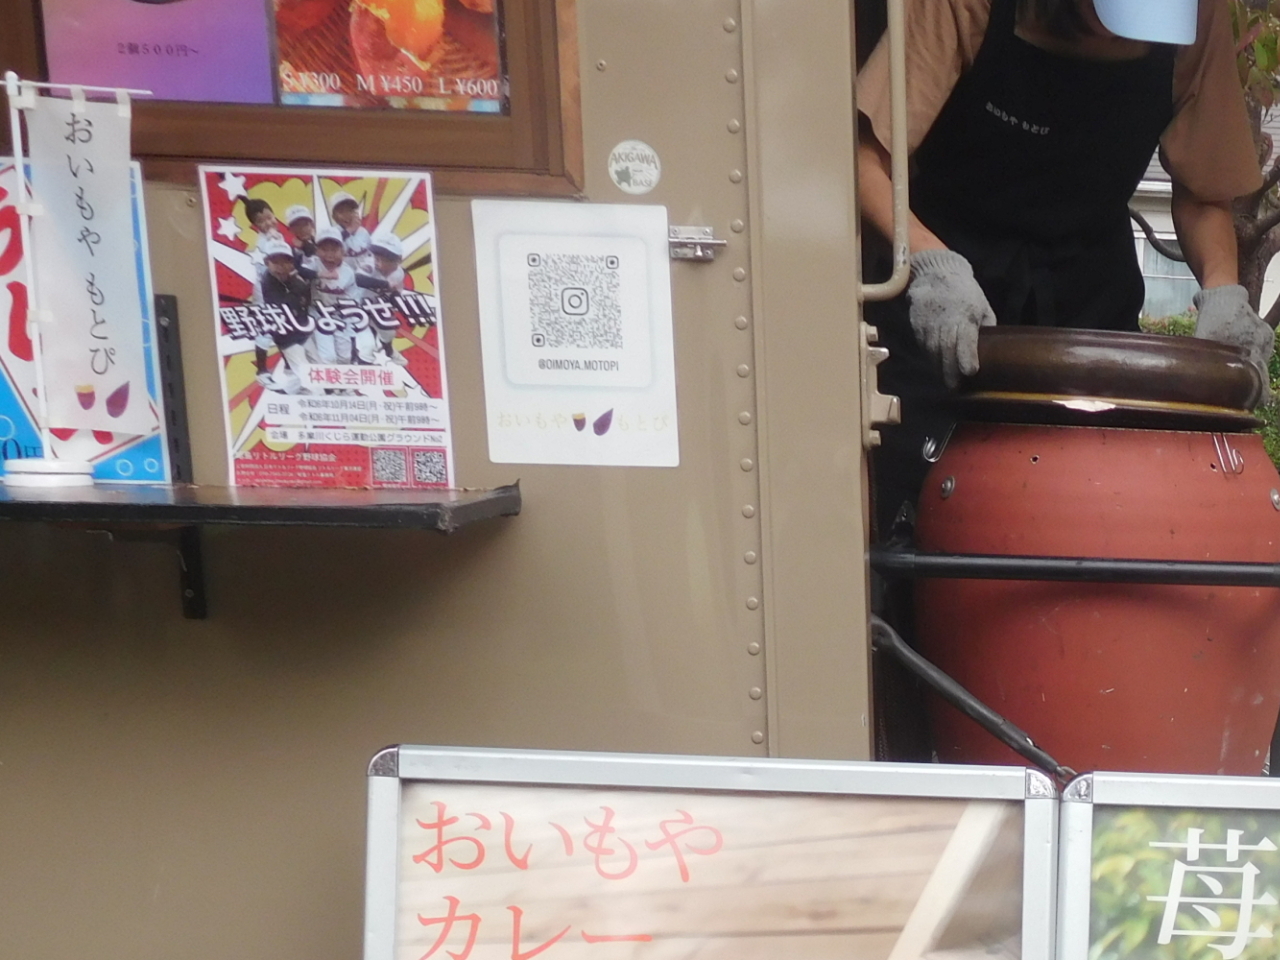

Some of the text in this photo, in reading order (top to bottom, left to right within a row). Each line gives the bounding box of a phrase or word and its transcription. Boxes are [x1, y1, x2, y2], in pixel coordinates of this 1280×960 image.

[297, 71, 341, 91] ¥300
[356, 73, 376, 93] M
[380, 75, 423, 94] ¥450
[439, 78, 452, 94] L
[455, 78, 499, 96] ¥600
[609, 151, 659, 171] AKIGAWA
[632, 178, 653, 188] BASE
[65, 113, 116, 375] おいもや もとぴ
[538, 358, 619, 372] @OIMOYA.MOTOPI
[308, 366, 395, 387] 体験会開催
[268, 402, 290, 416] 日程
[412, 800, 723, 883] おいもや
